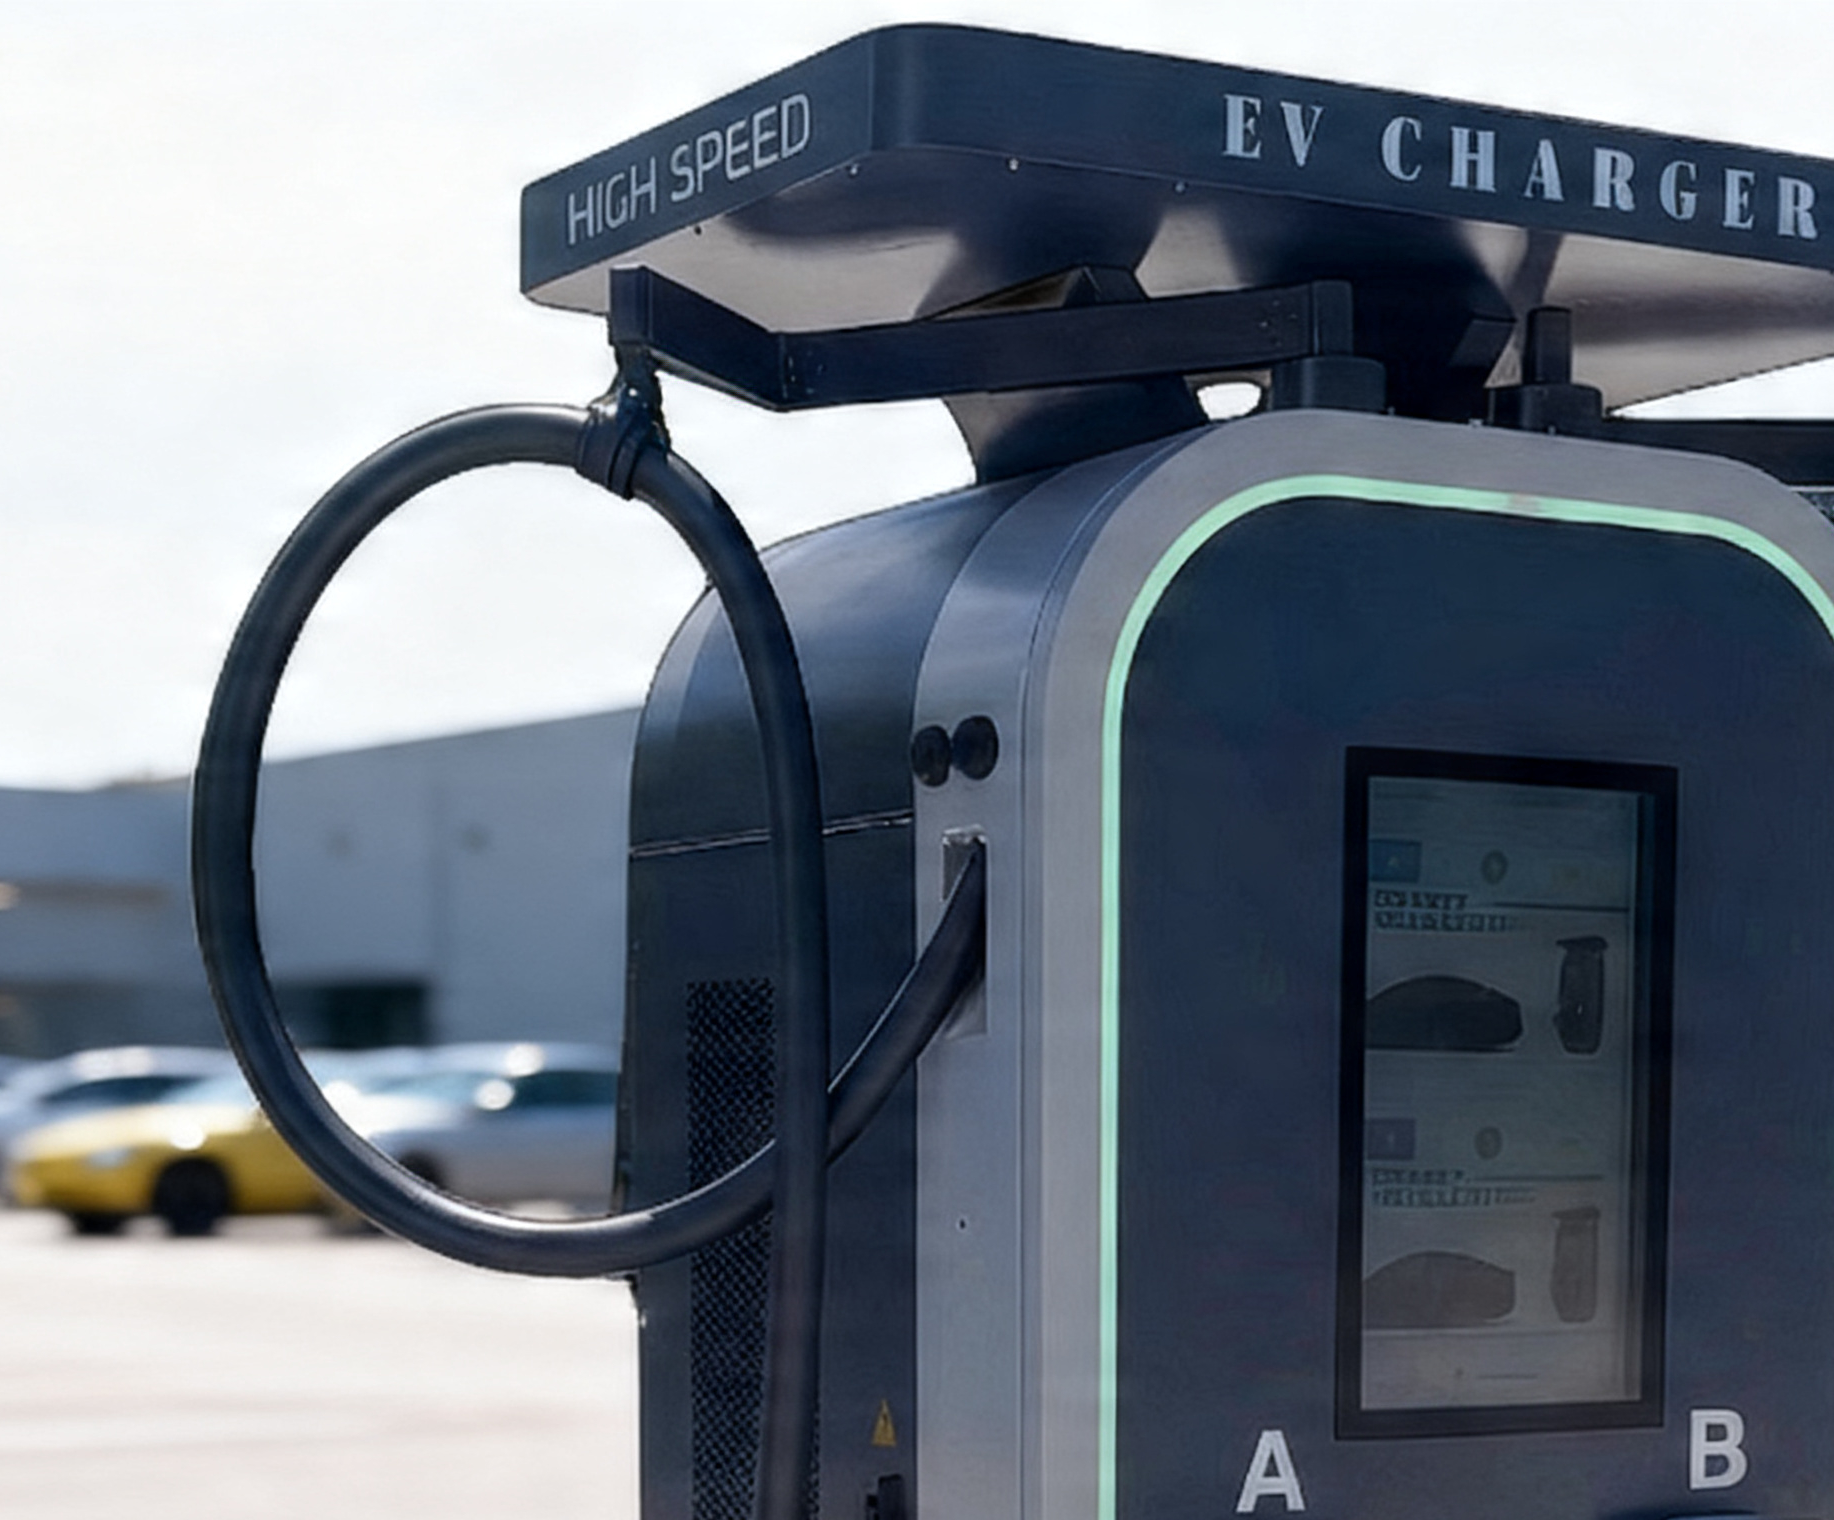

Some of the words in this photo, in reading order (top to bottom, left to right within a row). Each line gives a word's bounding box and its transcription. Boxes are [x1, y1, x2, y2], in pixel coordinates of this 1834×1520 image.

[568, 156, 657, 246] HIGH
[670, 93, 811, 203] SPEED
[1222, 93, 1325, 168] EV
[1379, 115, 1819, 240] CHARGER
[1235, 1430, 1306, 1513] A
[1688, 1408, 1748, 1490] B
